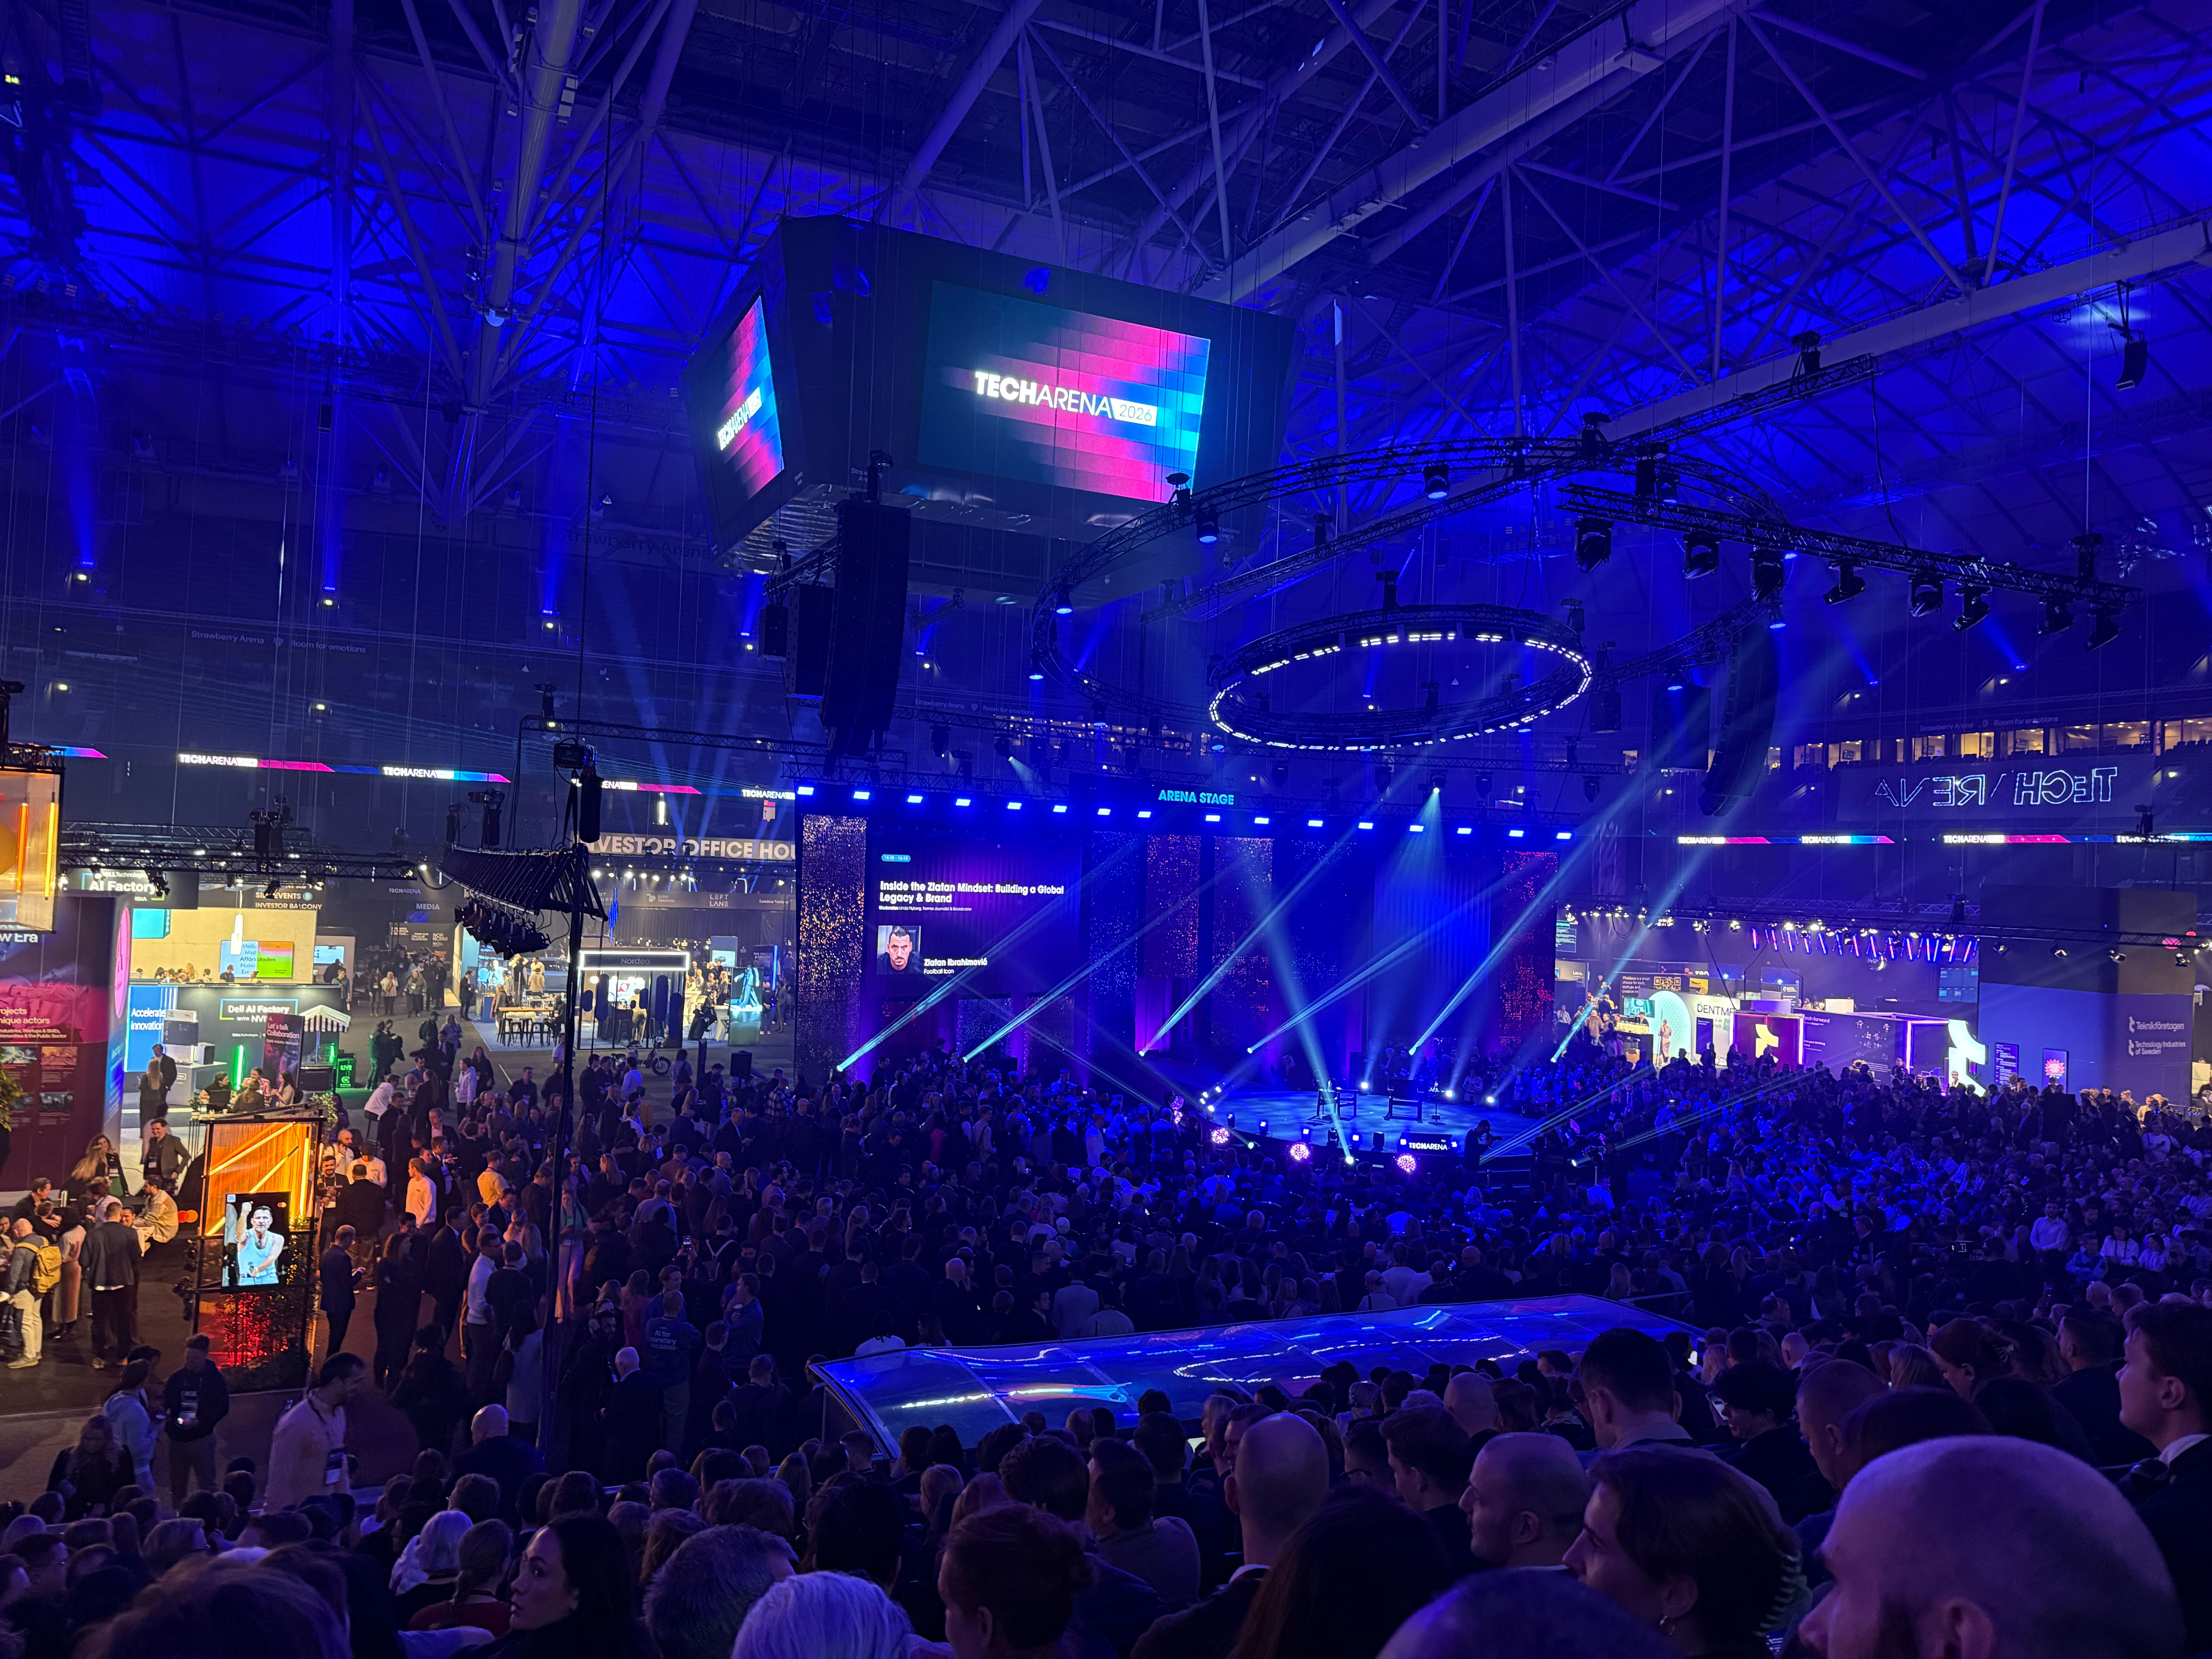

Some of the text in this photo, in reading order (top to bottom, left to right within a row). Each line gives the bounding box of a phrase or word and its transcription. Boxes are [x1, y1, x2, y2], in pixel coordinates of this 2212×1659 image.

[975, 371, 1152, 421] TECHARENA 2026
[191, 630, 237, 642] Strawberry
[239, 636, 264, 644] Arena
[290, 640, 314, 648] Room
[328, 644, 366, 653] emotions
[915, 699, 947, 708] Strawberry
[1009, 707, 1034, 715] emotions
[179, 754, 238, 766] TECHARENA
[383, 767, 436, 778] TECHARENA
[742, 789, 787, 800] TECHARENA
[1158, 790, 1234, 805] ARENA STAGE
[1801, 836, 1838, 844] TECHARENA
[1943, 835, 1989, 843] TECHARENA
[683, 840, 753, 858] OFFICE
[89, 880, 155, 895] AI Factory
[880, 880, 909, 891] Inside
[910, 881, 926, 891] the
[927, 882, 955, 892] Zlatan
[957, 883, 993, 893] Mindset:
[995, 884, 1029, 896] Building
[1037, 885, 1064, 894] Global
[879, 892, 952, 904] Legacy & Brand
[14, 933, 38, 943] Era
[131, 1008, 166, 1018] Accelerate
[228, 1005, 244, 1013] Dell
[257, 1005, 290, 1014] Factory
[2136, 1022, 2185, 1032] Teknikföretagen
[266, 1030, 300, 1039] Collaboration
[1408, 1142, 1448, 1151] TECHARENA
